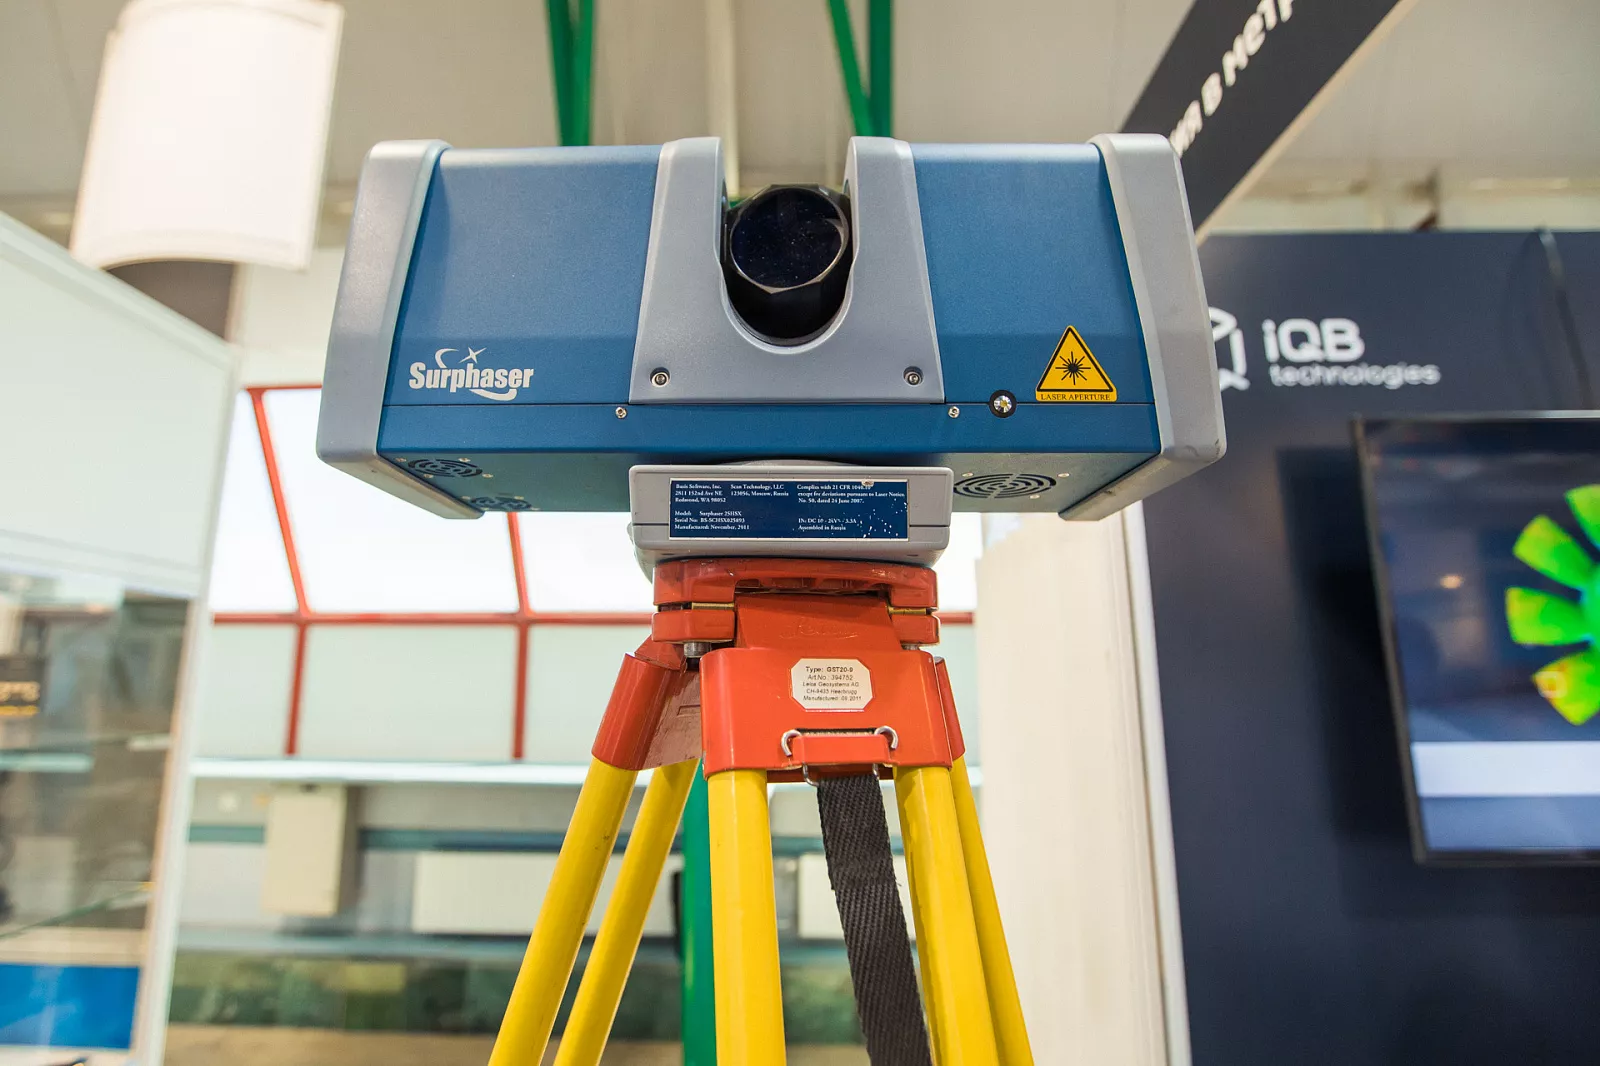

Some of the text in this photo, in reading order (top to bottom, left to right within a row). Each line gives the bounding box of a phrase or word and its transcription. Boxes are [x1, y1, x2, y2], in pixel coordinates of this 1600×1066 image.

[1261, 318, 1366, 363] iQB
[408, 362, 534, 400] Surphaser
[1269, 362, 1442, 390] technologies
[1041, 393, 1111, 401] LASER APERTURE
